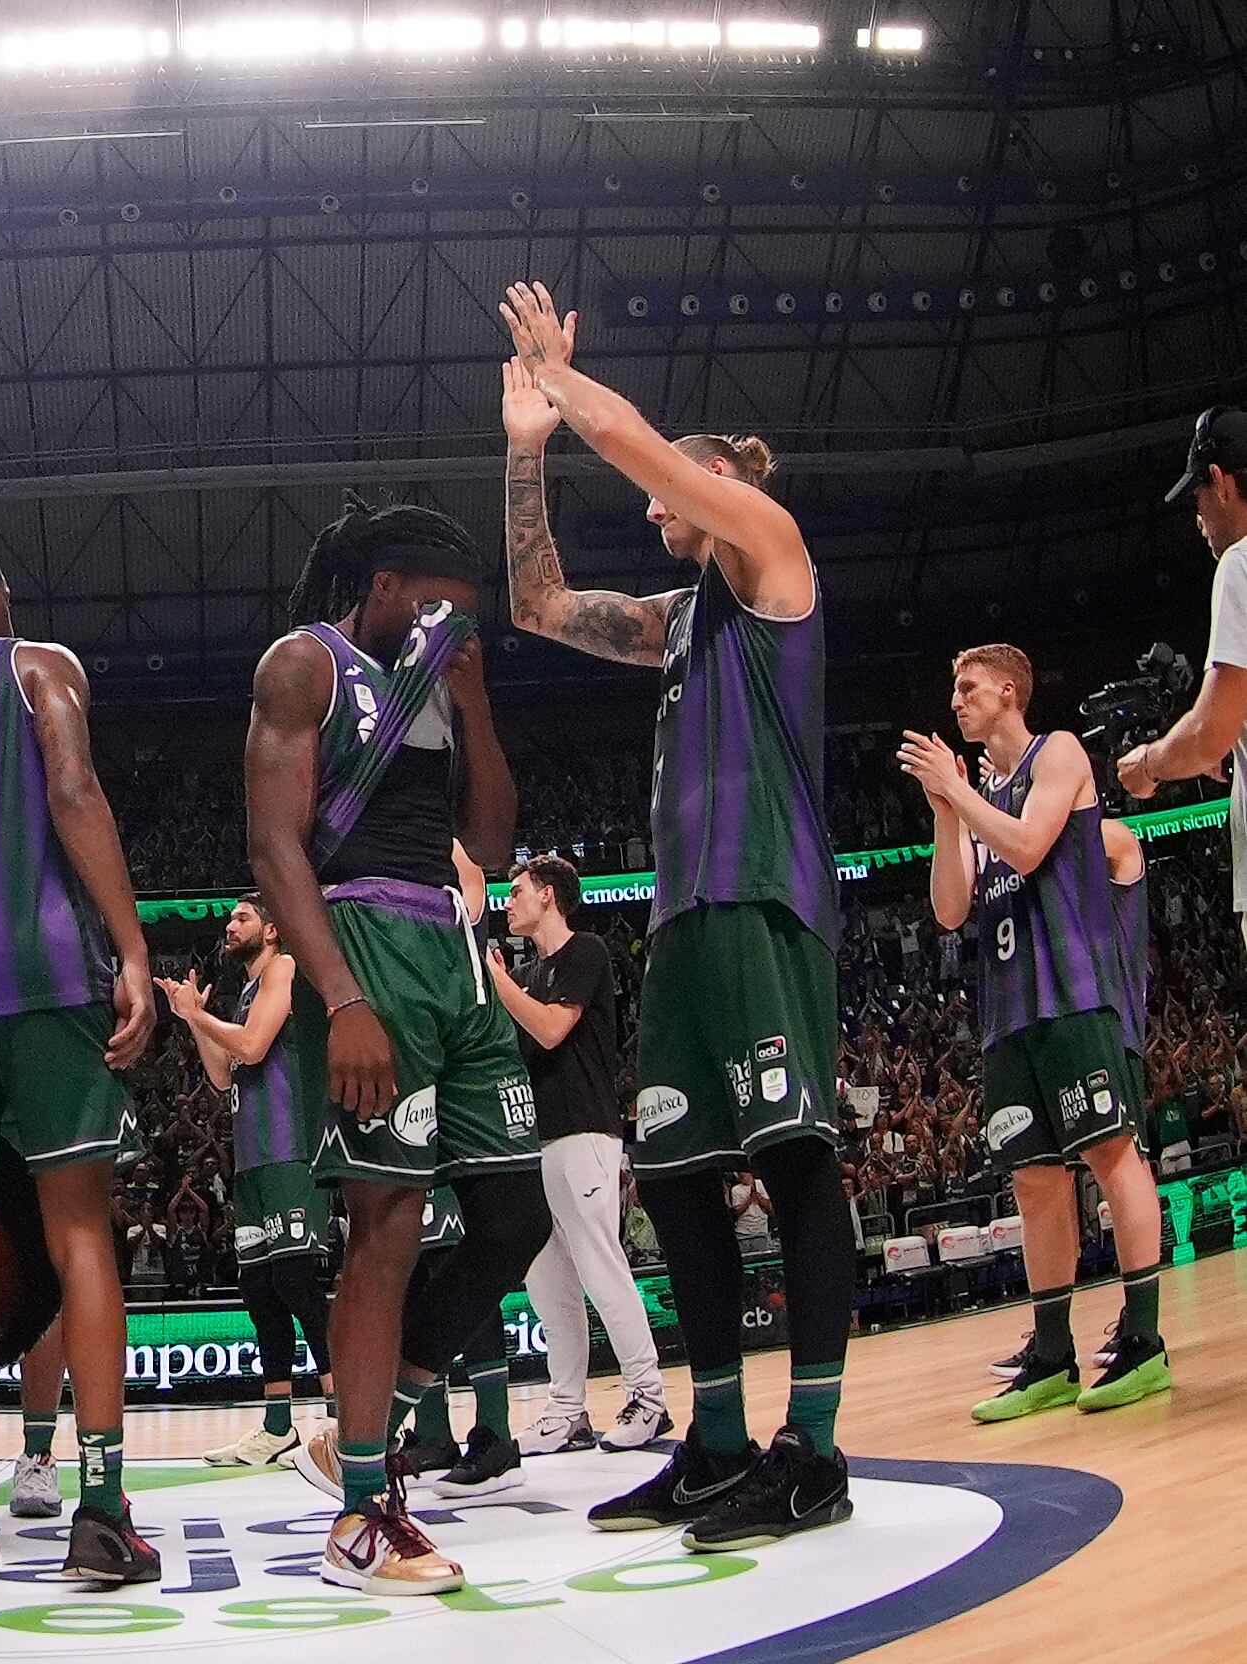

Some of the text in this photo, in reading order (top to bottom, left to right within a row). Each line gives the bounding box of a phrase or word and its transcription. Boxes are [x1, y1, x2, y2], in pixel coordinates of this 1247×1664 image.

[1145, 819, 1182, 842] para
[996, 916, 1017, 962] 9
[758, 1045, 780, 1059] acb
